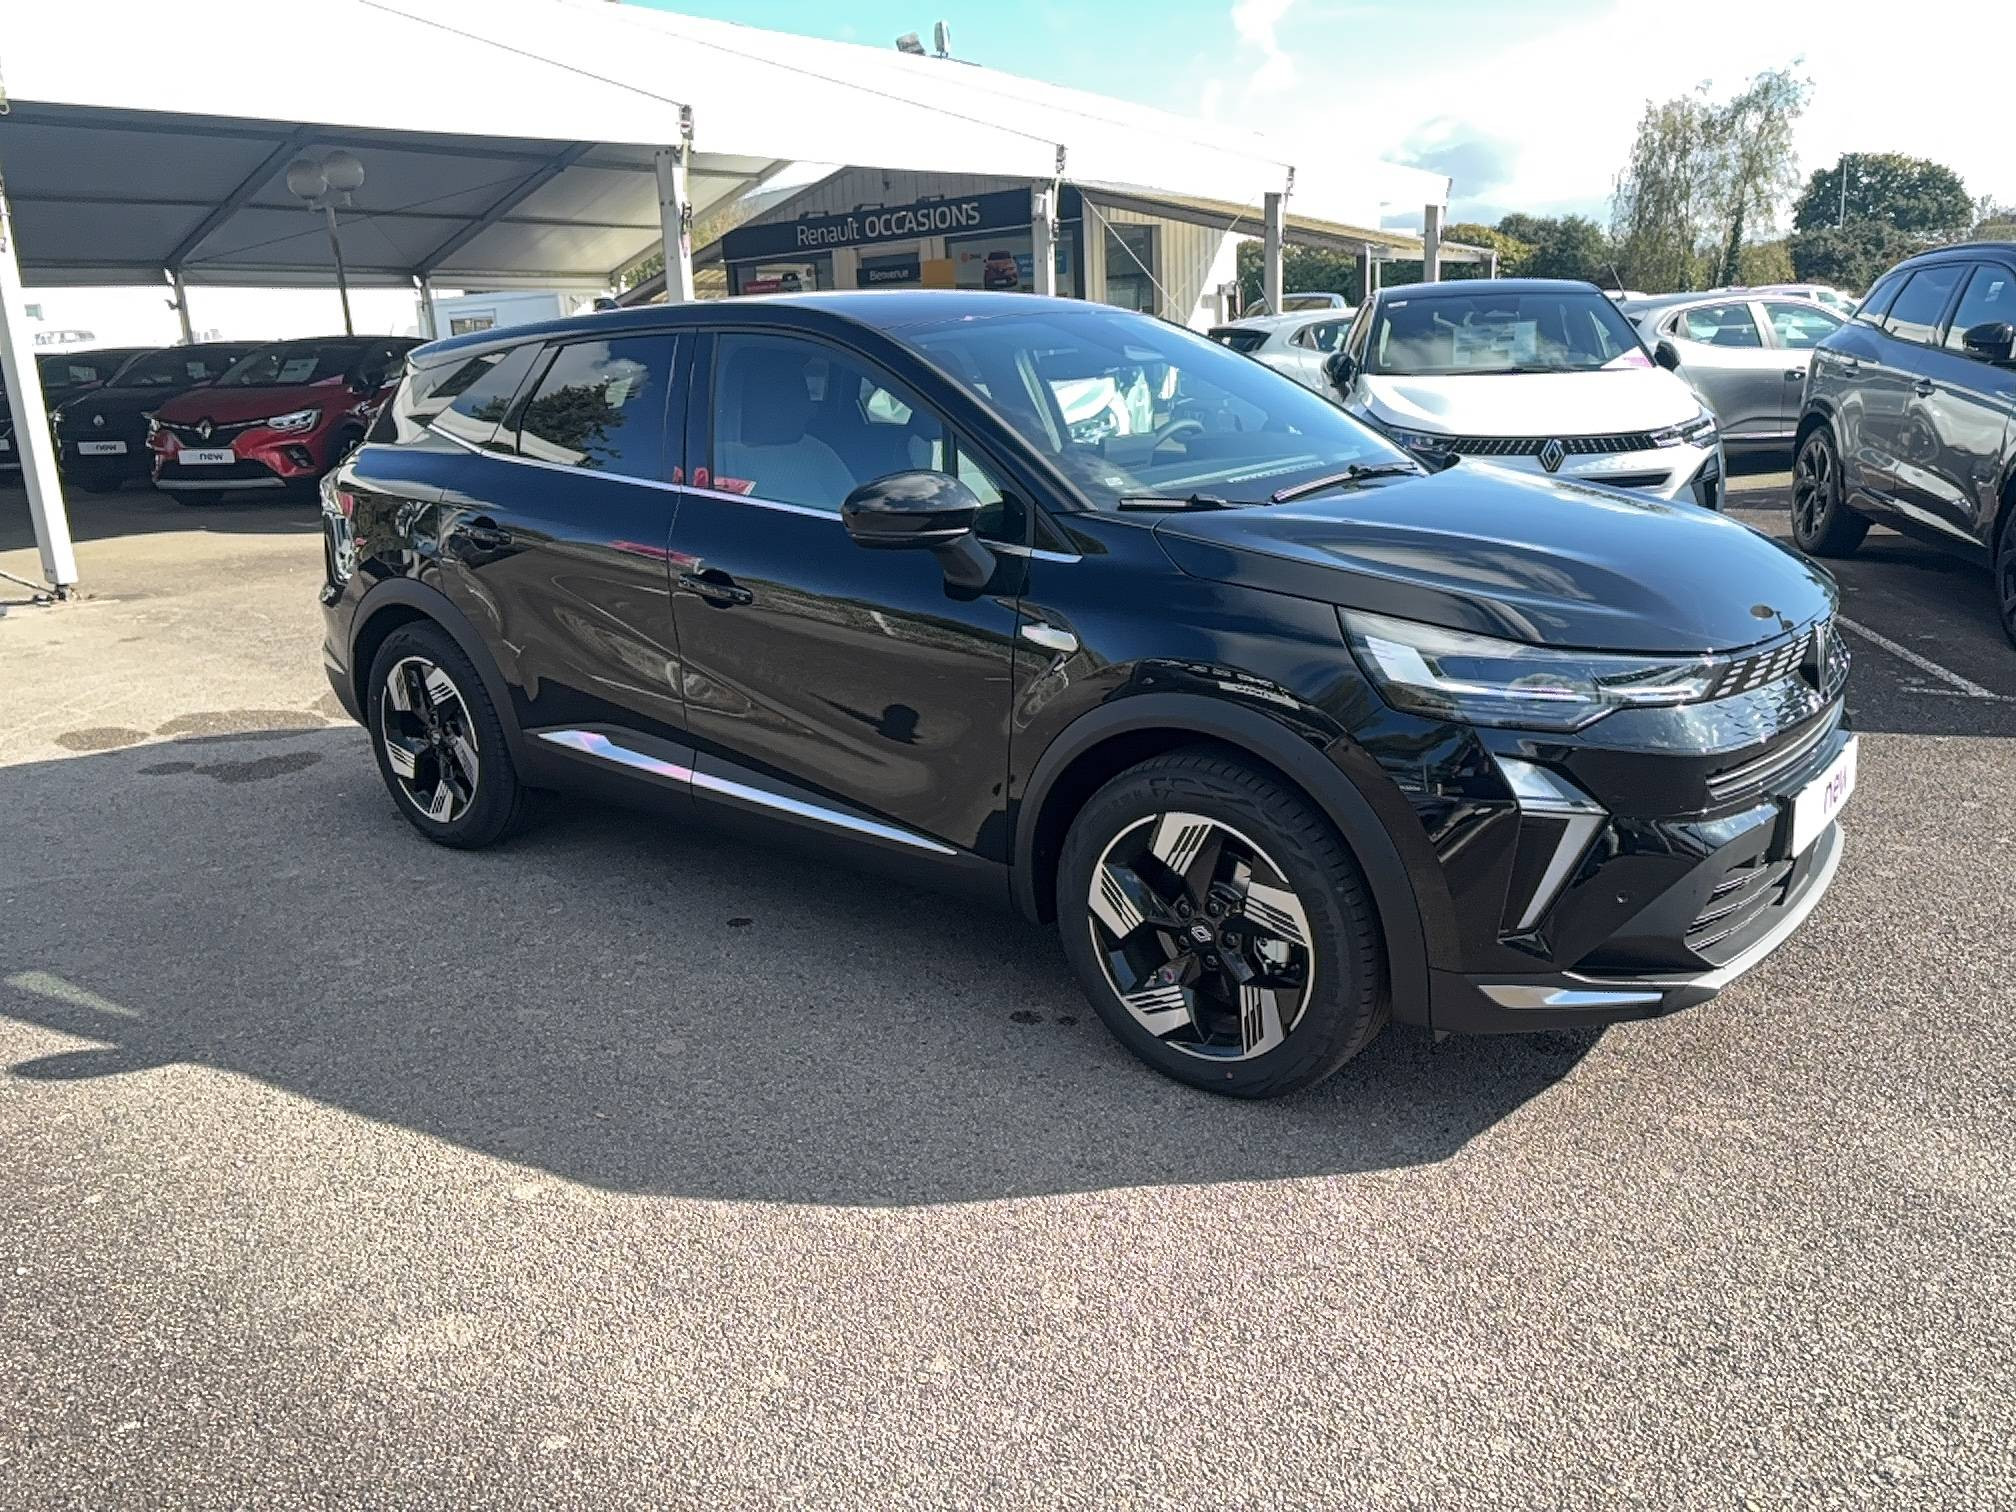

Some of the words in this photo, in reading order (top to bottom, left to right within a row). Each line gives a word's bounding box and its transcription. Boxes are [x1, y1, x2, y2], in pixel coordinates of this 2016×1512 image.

[797, 217, 860, 246] Renault
[865, 203, 980, 238] OCCASIONS
[199, 452, 224, 461] new
